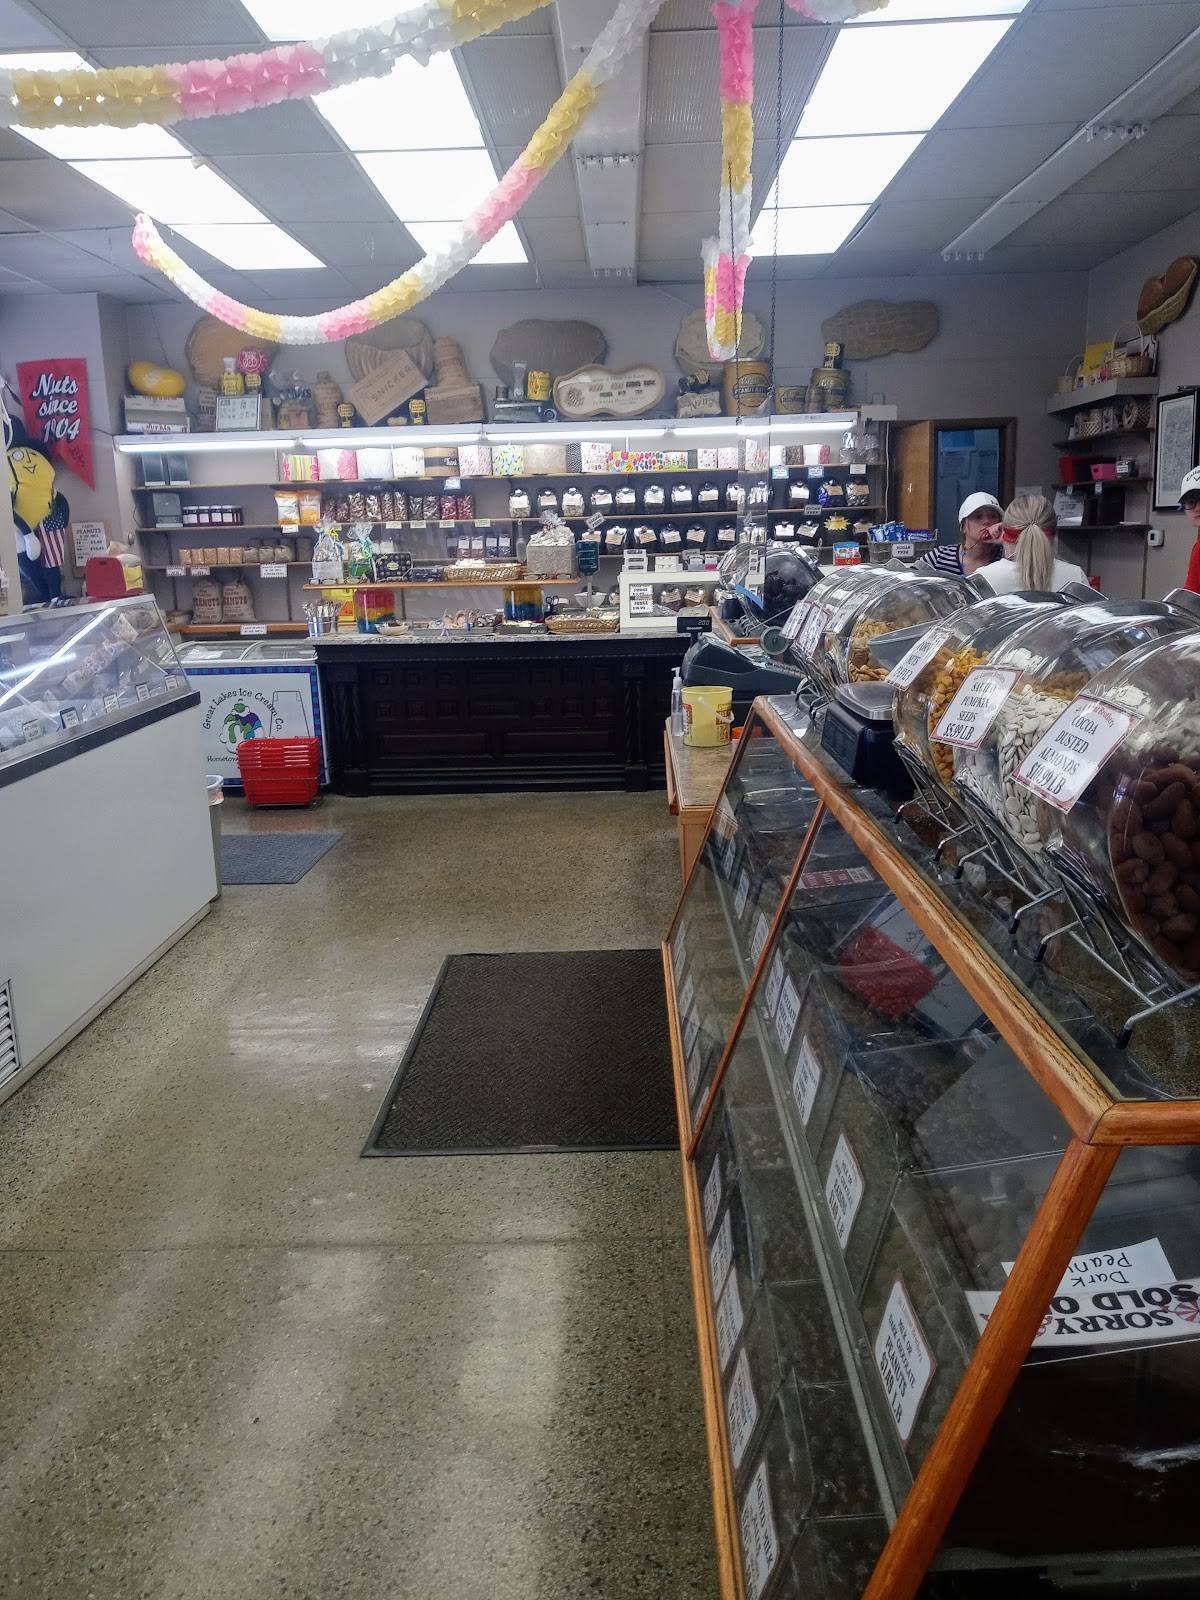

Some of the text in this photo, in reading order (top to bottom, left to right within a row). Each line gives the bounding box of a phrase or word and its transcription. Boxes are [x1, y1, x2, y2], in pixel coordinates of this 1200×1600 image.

[31, 373, 79, 398] Nuts
[38, 396, 78, 417] since
[202, 688, 284, 732] Great Lakes Ice Cream Co.
[960, 696, 990, 708] PUMPKIN
[958, 710, 976, 722] SEEDS
[1071, 716, 1098, 736] COCOA
[1054, 730, 1089, 754] DUSTED
[1038, 746, 1080, 776] ALMONDS
[1068, 1252, 1133, 1273] Pean
[1071, 1271, 1130, 1288] Dark
[1090, 1284, 1200, 1311] SOLD
[1054, 1308, 1174, 1335] SORRY
[886, 1336, 908, 1398] PEANUTS
[896, 1338, 916, 1389] CHOCOLATE
[891, 1392, 903, 1424] LB
[764, 1528, 774, 1570] MILK
